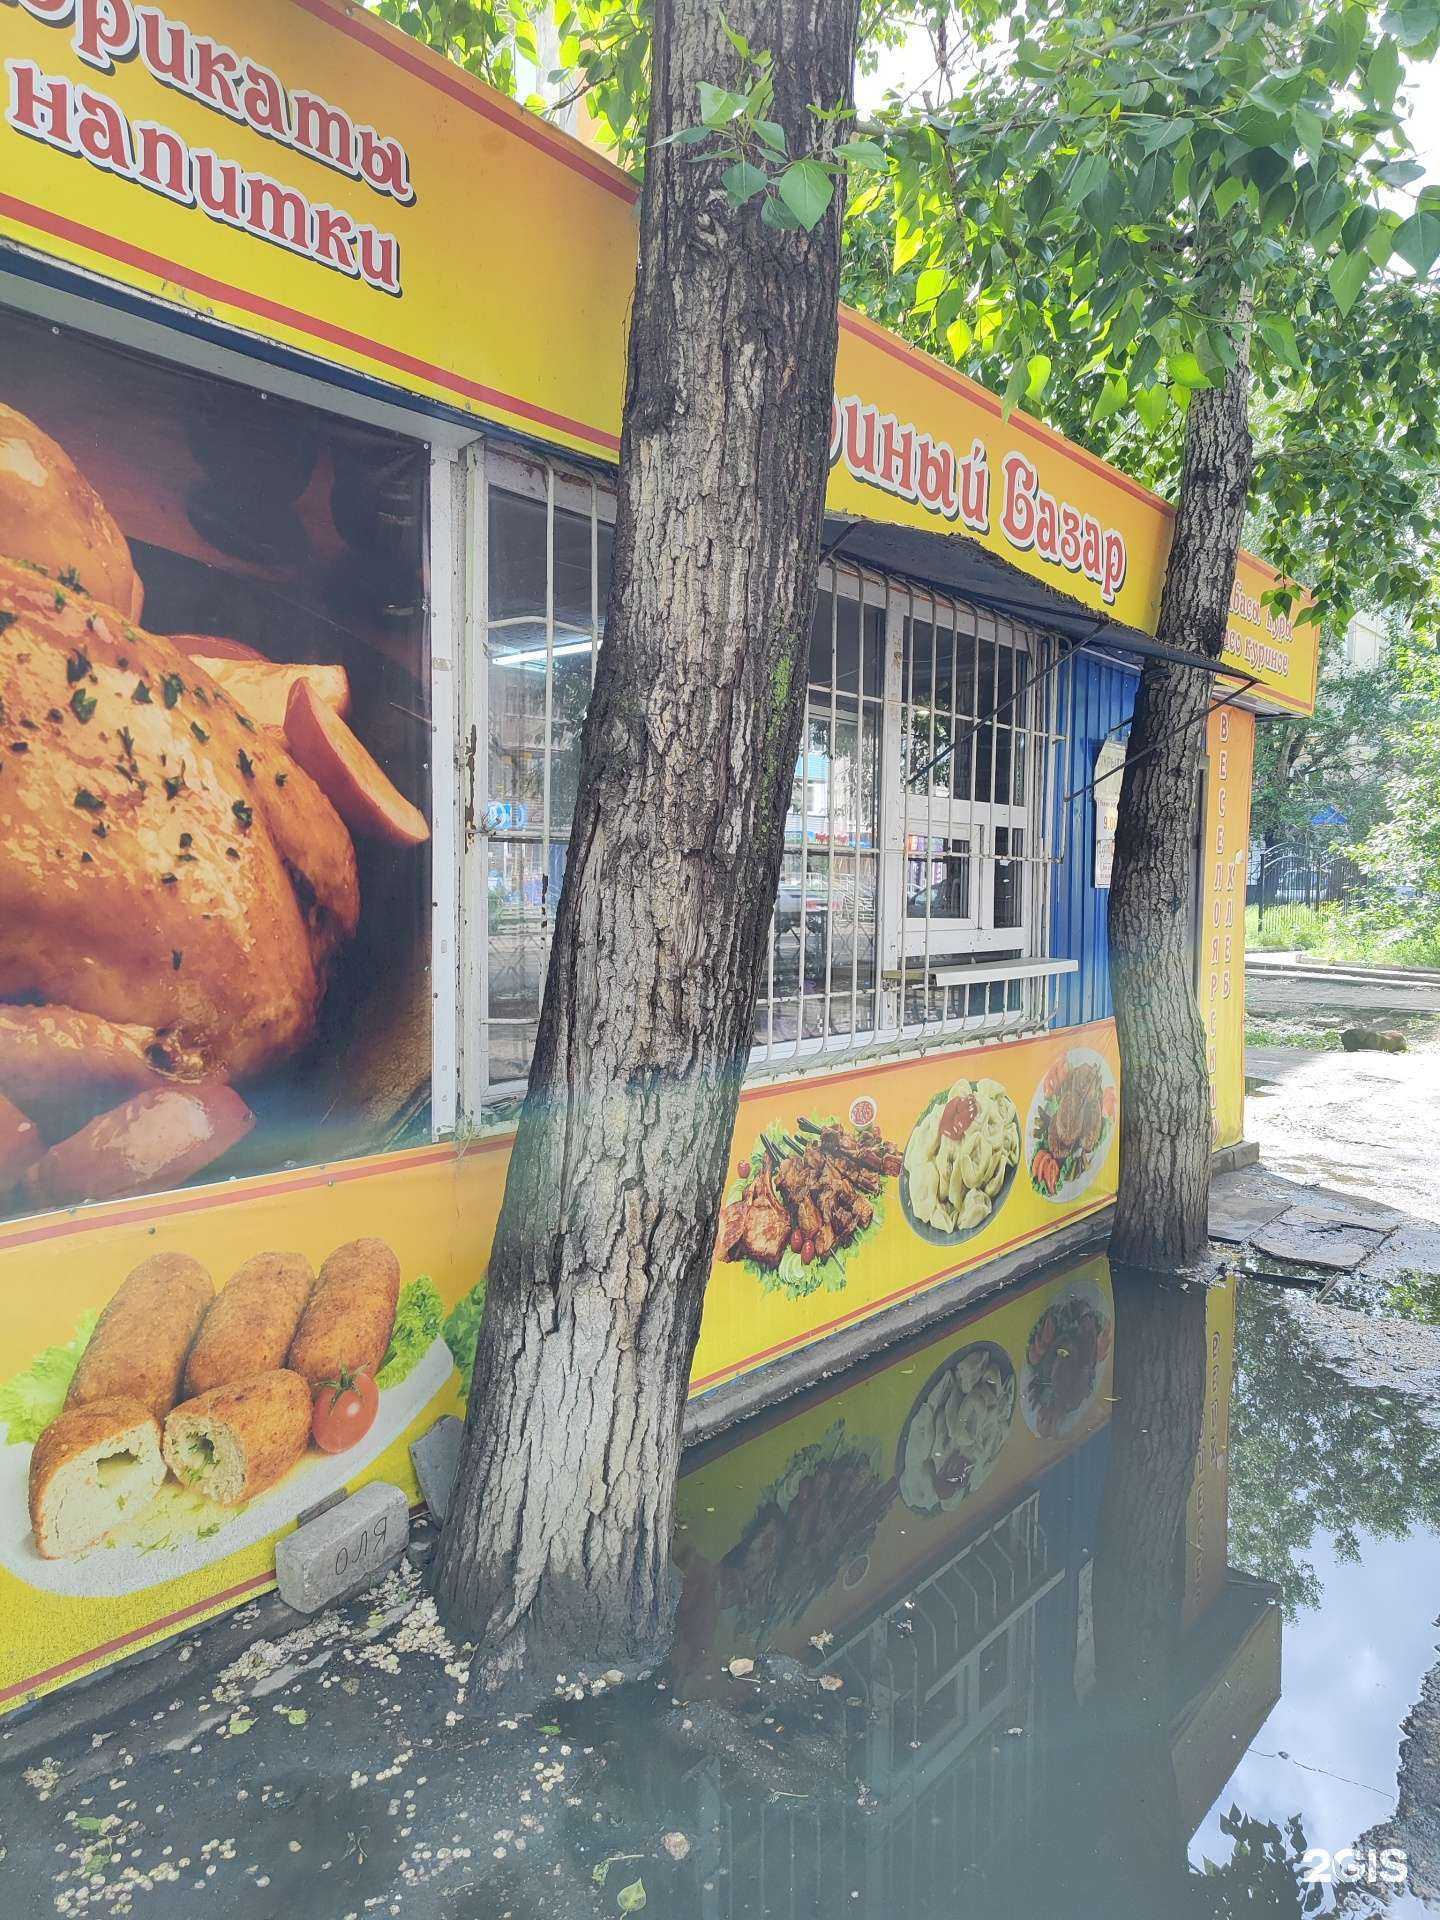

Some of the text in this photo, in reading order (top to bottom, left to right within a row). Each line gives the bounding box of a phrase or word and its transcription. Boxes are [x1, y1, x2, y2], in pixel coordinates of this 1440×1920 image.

[14, 0, 414, 203] рикаты
[1001, 450, 1126, 603] Базар
[1229, 579, 1262, 626] басы
[1222, 862, 1237, 1000] ХЛЕБ
